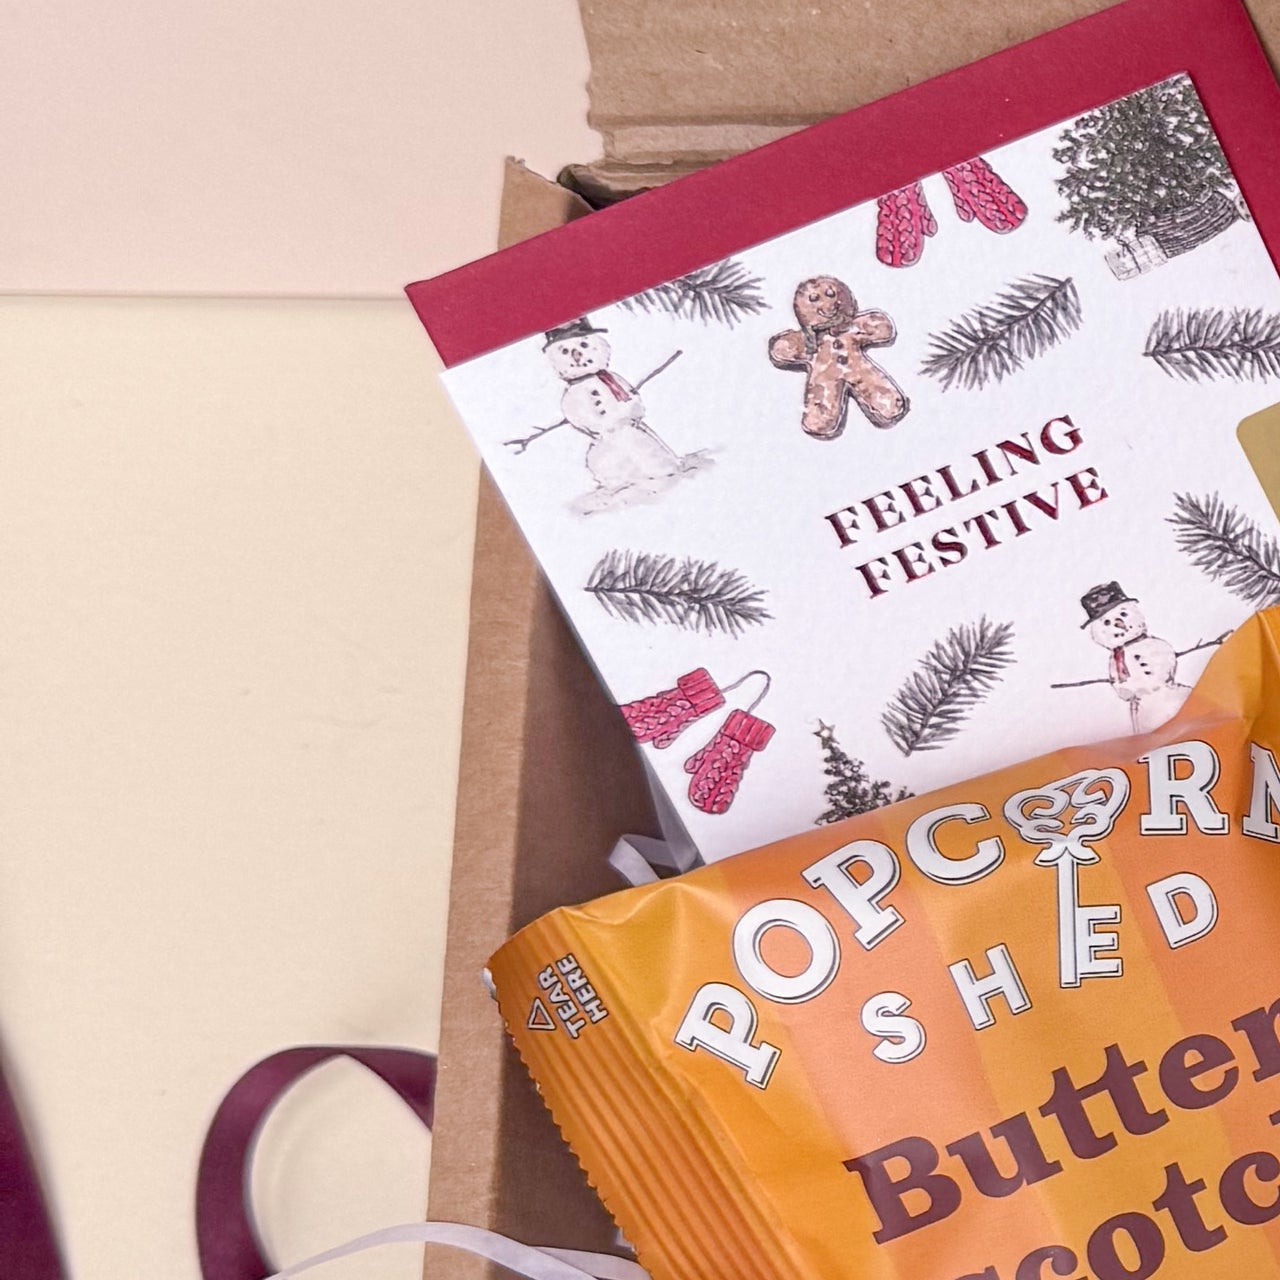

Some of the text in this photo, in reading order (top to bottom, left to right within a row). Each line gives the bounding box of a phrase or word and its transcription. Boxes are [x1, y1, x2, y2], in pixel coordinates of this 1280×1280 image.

[824, 413, 1087, 549] FEELING
[854, 465, 1110, 600] FESTIVE
[537, 964, 587, 1040] TEAR
[555, 953, 609, 1025] HERE
[860, 860, 1219, 1065] SHED
